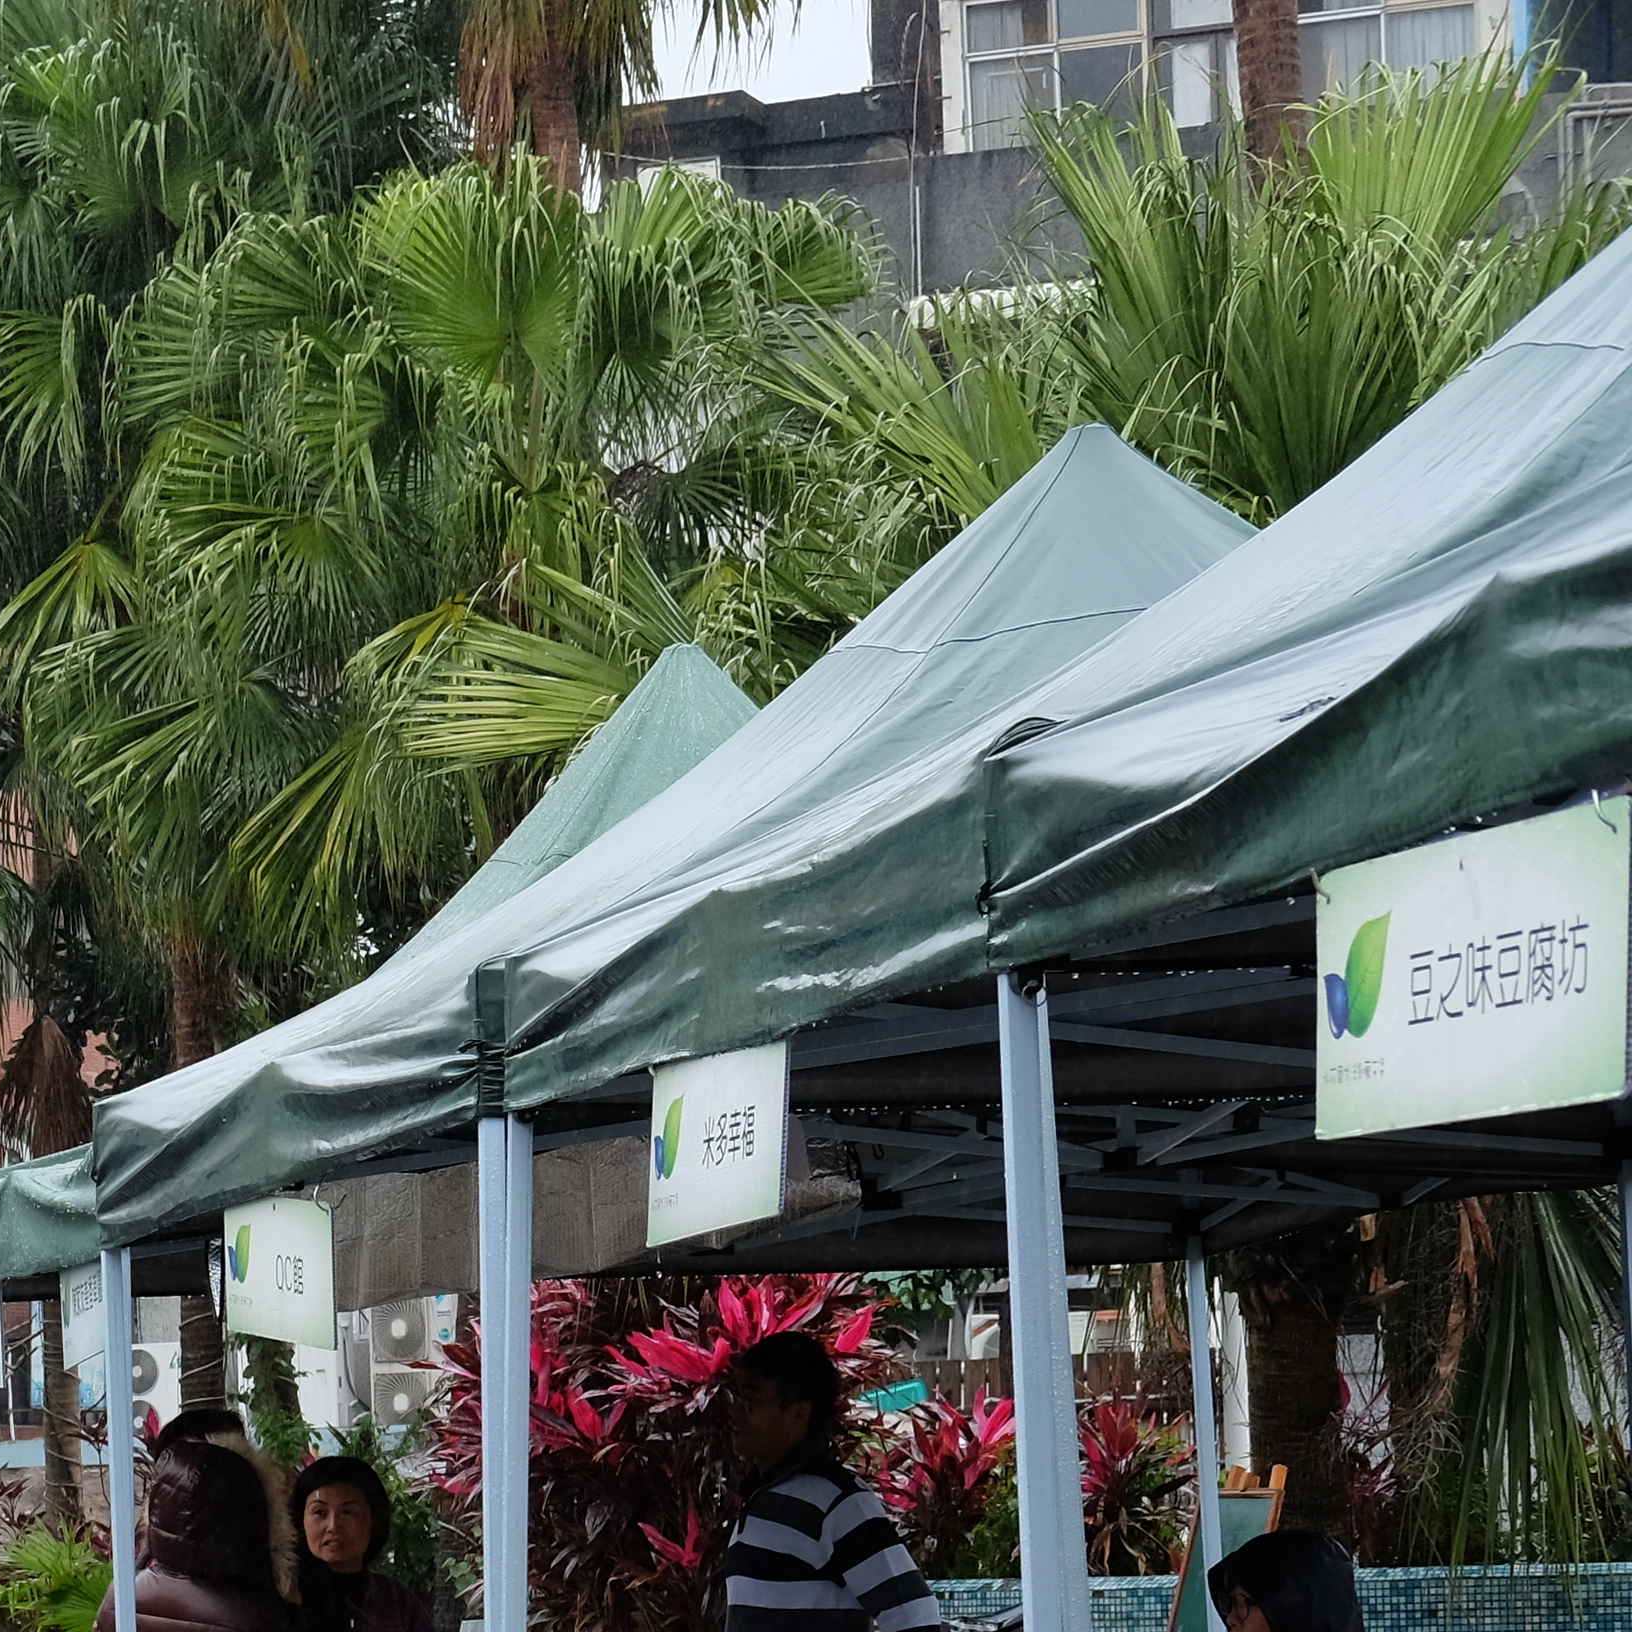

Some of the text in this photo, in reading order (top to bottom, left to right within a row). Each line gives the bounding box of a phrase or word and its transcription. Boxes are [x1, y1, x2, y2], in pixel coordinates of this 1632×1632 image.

[1408, 915, 1589, 1026] 豆之味豆腐坊
[702, 1105, 756, 1169] 米多幸福
[275, 1254, 304, 1295] QC館
